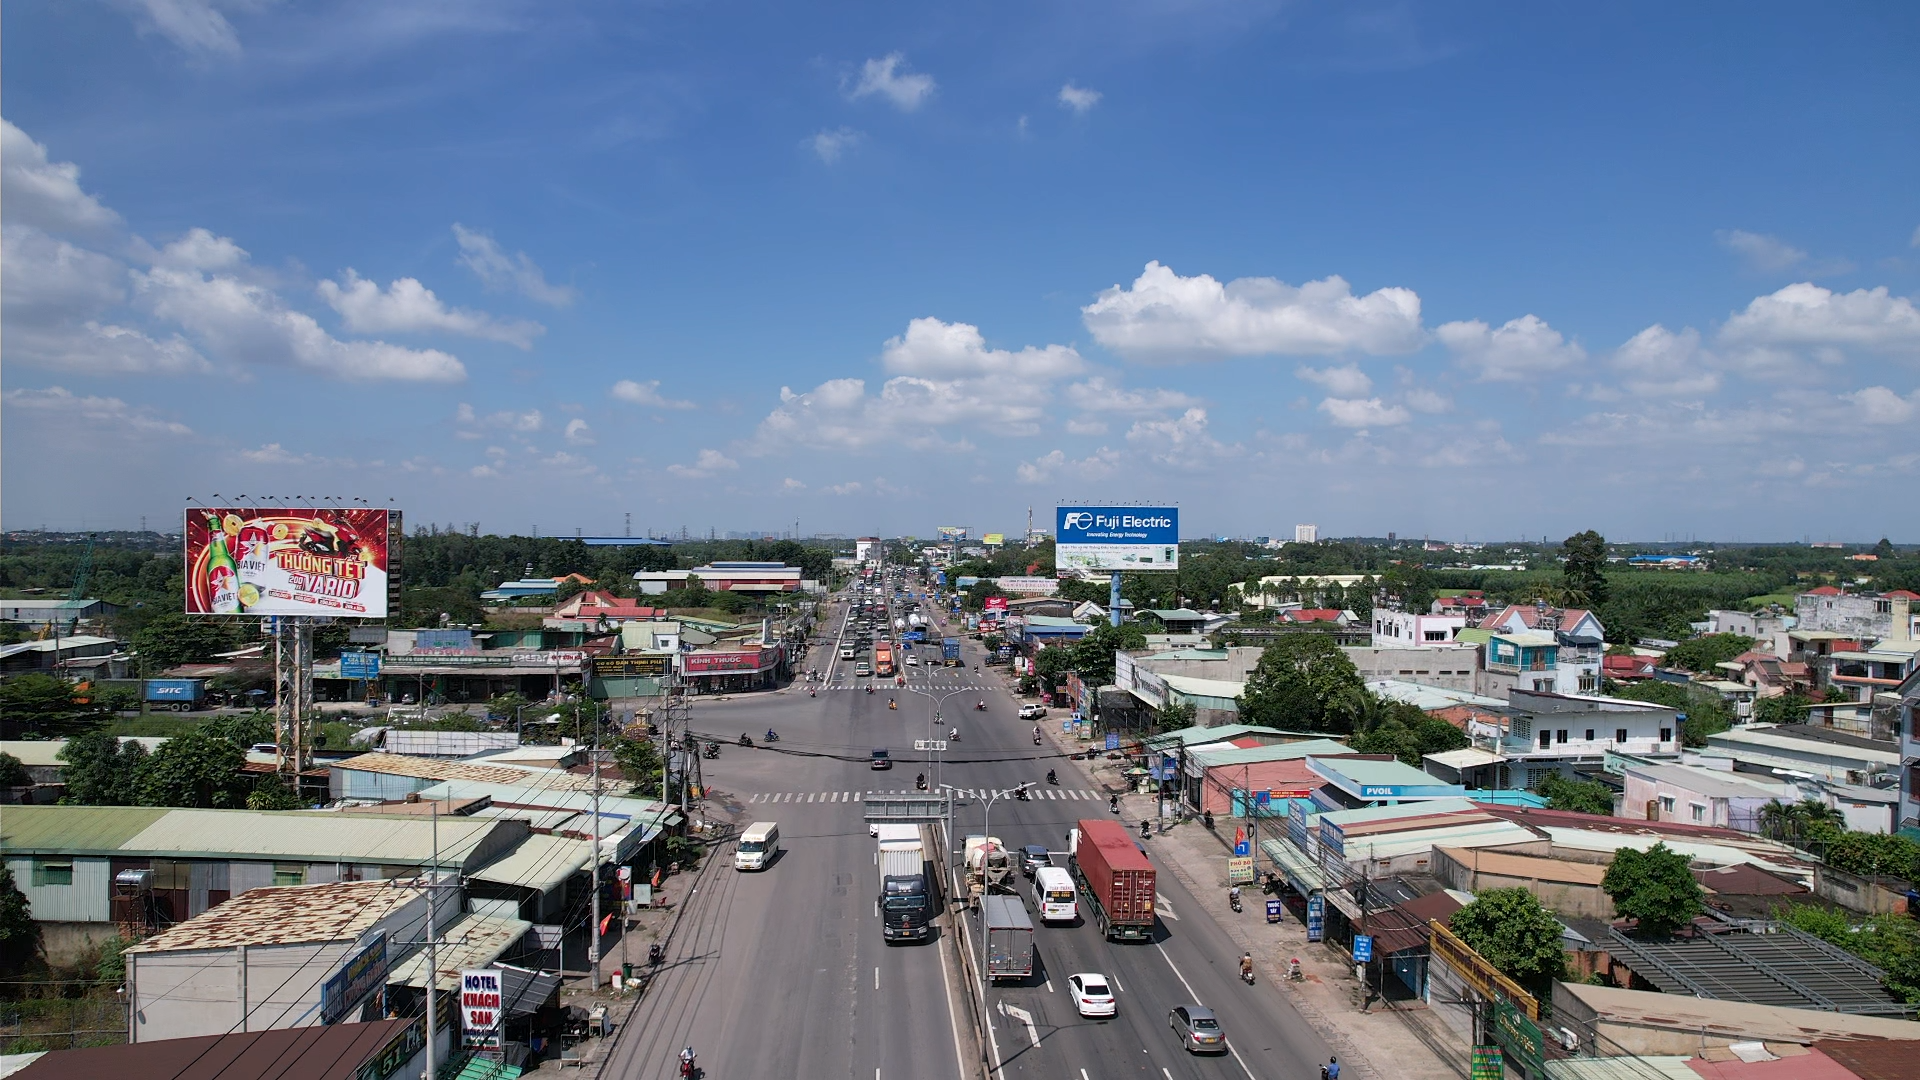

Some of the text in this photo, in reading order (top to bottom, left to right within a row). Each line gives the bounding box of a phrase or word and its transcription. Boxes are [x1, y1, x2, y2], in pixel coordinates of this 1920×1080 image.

[1096, 515, 1120, 530] Fuji
[1122, 515, 1171, 528] Electric
[1086, 531, 1108, 539] Innovating
[1124, 531, 1148, 539] Technology
[276, 551, 366, 579] THƯỞNG TẾT
[288, 575, 303, 584] 200
[302, 574, 357, 599] VARIO
[714, 655, 741, 663] THUỐC
[1366, 787, 1393, 795] PVOIL
[465, 975, 497, 990] HOTEL
[463, 990, 499, 1008] KHÁCH
